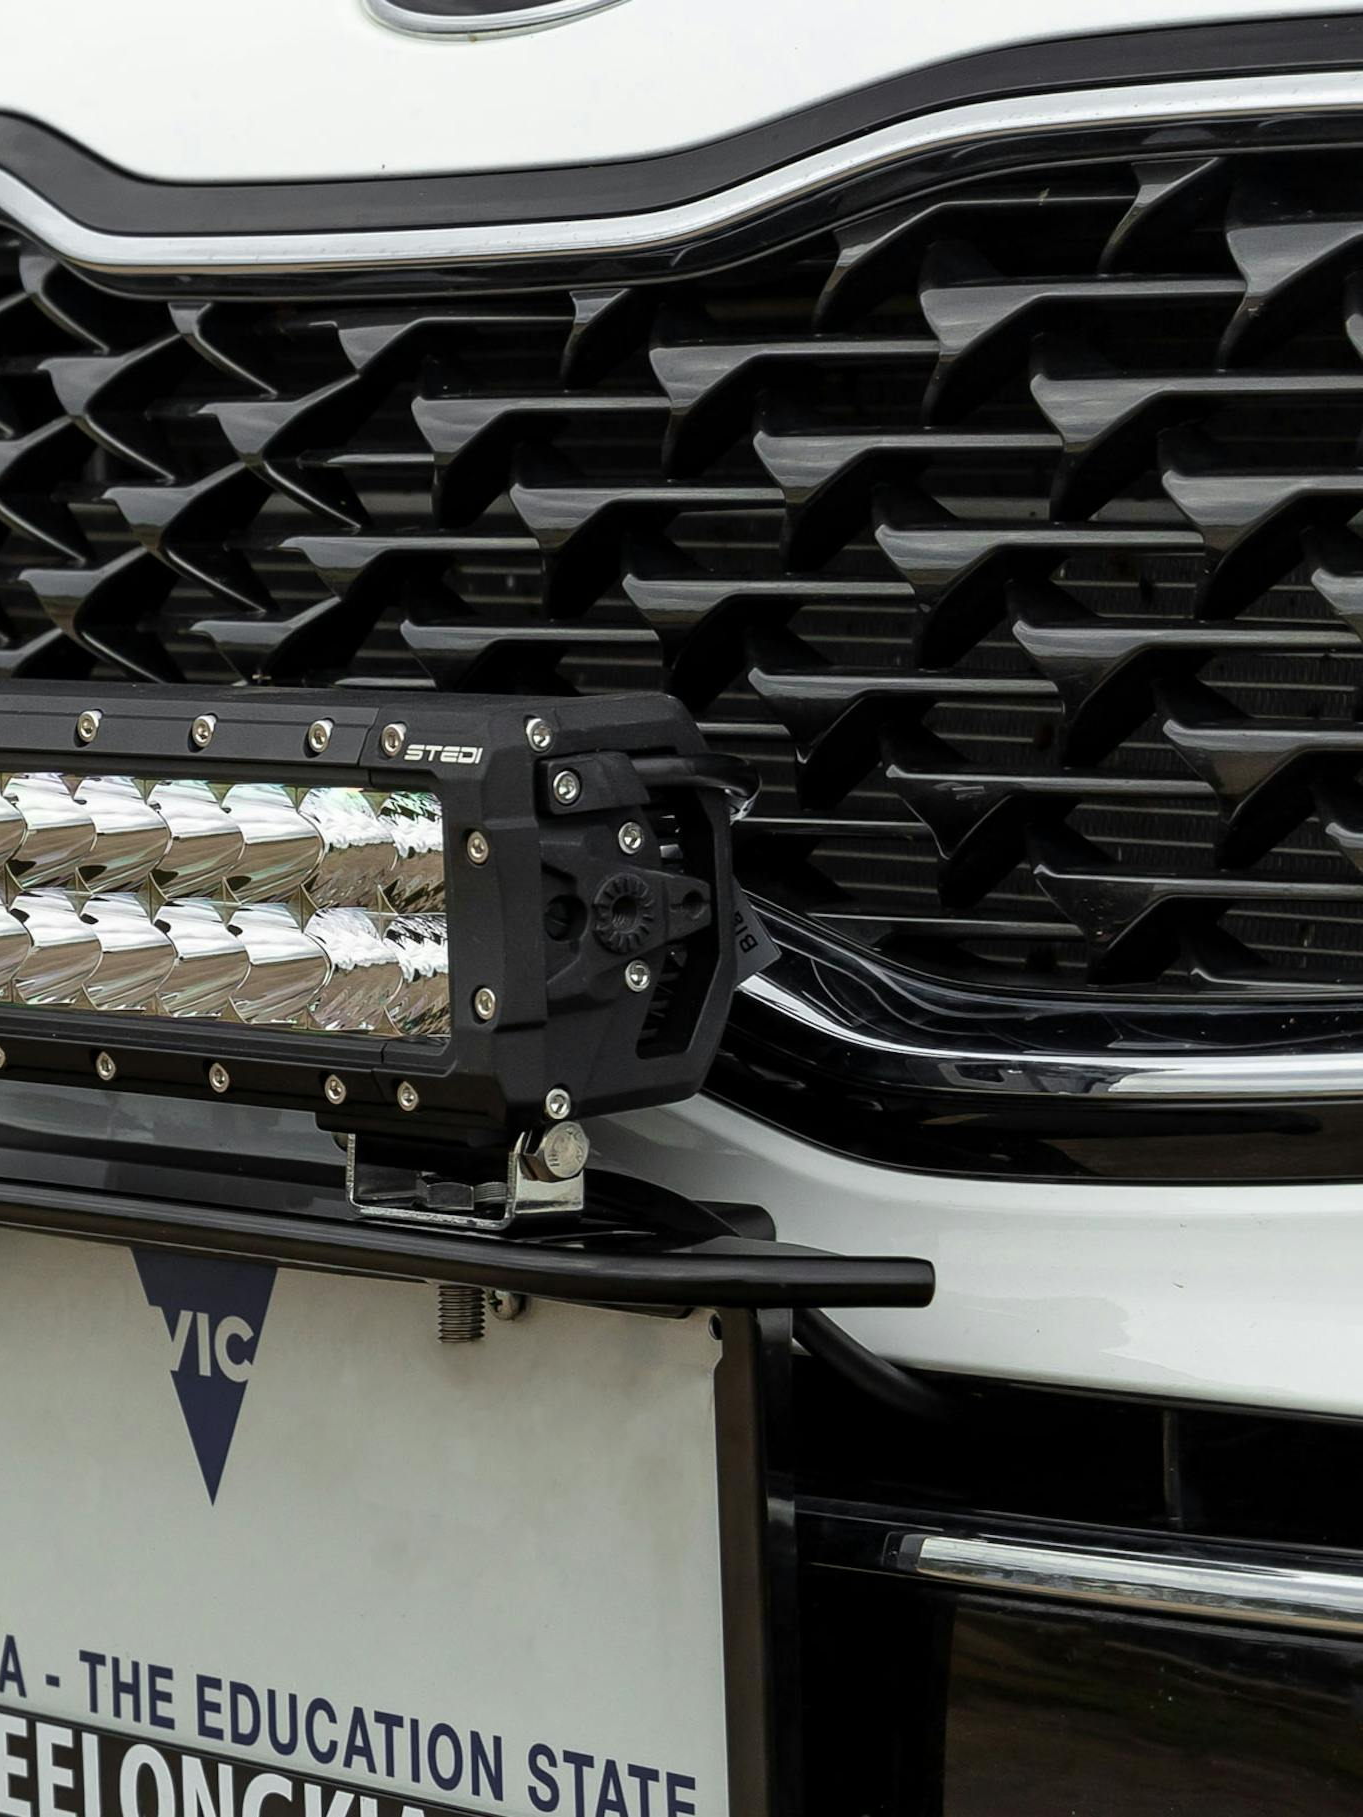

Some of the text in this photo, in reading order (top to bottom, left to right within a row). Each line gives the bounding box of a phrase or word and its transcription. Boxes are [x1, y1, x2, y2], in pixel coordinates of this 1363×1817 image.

[404, 744, 483, 764] STEDI
[148, 1304, 255, 1383] VIC
[79, 1649, 176, 1730] THE
[195, 1673, 504, 1802] EDUCATION
[527, 1743, 696, 1817] STATE
